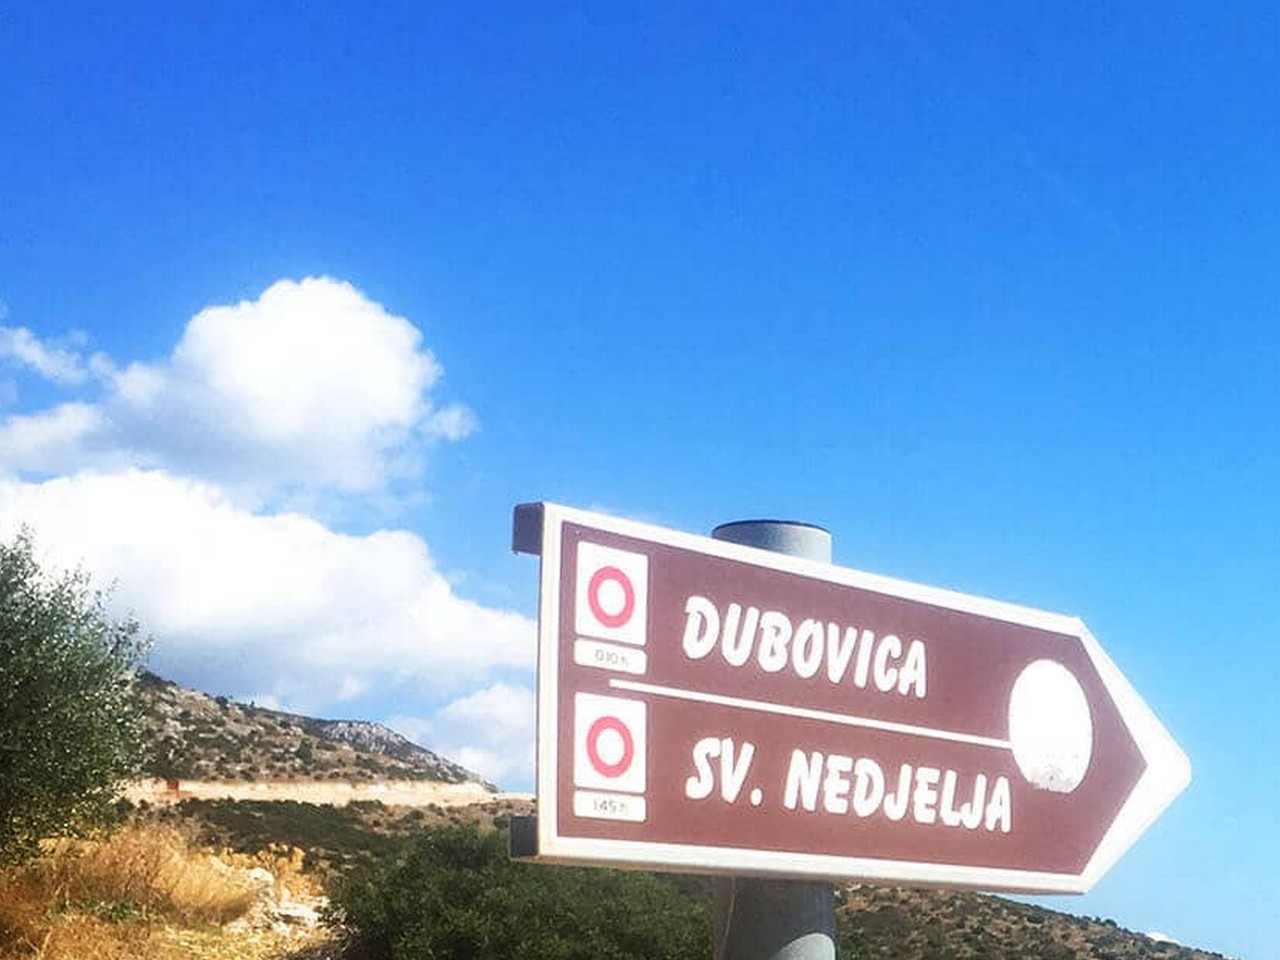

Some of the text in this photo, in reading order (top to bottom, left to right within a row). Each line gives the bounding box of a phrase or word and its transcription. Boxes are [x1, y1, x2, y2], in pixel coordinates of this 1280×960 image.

[682, 595, 927, 698] DUBOVICA
[685, 737, 1012, 833] SV. NEDJELJA
